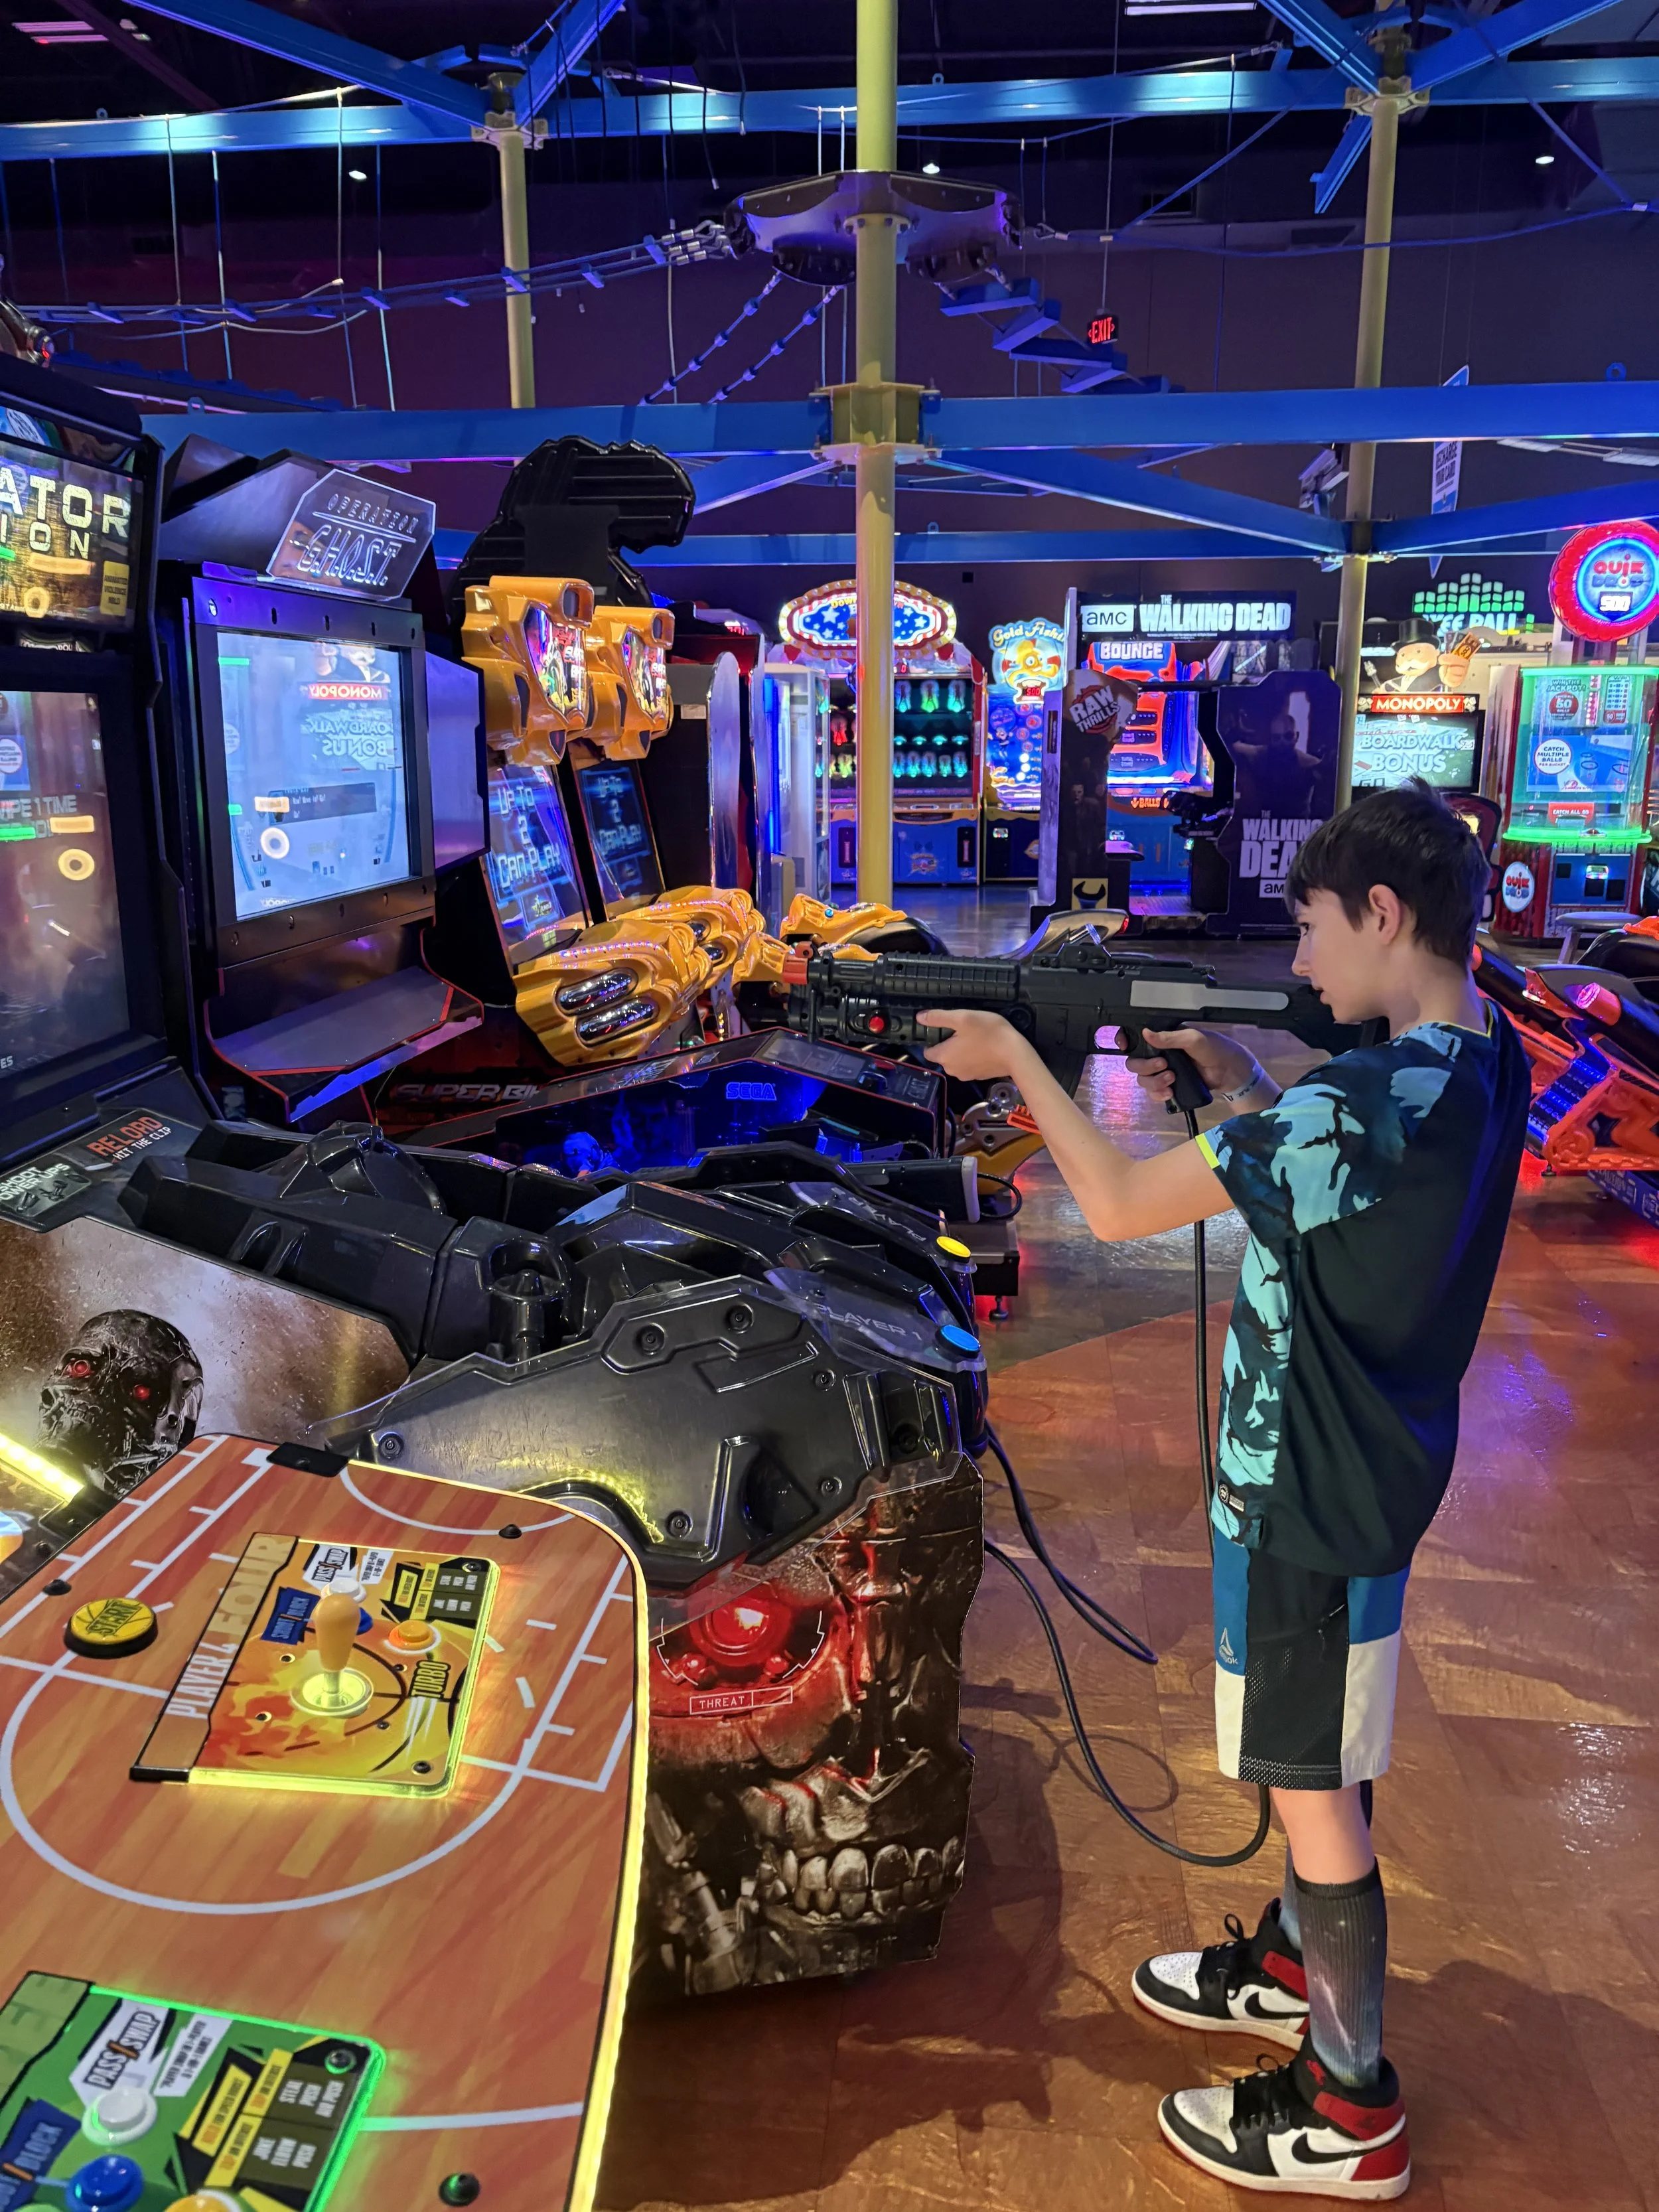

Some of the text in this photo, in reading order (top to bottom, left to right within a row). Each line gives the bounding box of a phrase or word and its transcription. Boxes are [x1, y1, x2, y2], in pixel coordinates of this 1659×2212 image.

[1092, 317, 1113, 344] EXIT
[0, 467, 132, 538] ATOR
[327, 493, 419, 534] OPERATION
[1160, 594, 1173, 605] THE
[1600, 595, 1631, 612] 500
[1139, 603, 1234, 632] WALKING
[1235, 602, 1292, 631] DEAD
[993, 625, 1024, 647] Gold
[1100, 642, 1164, 660] BOUNCE
[1026, 688, 1041, 696] 500
[1555, 698, 1573, 709] 60
[1069, 685, 1115, 723] RAW
[1376, 697, 1461, 711] MONOPOLY
[1076, 701, 1121, 733] THRILLS
[1361, 733, 1462, 751] BOARDWALK
[1372, 751, 1447, 773] BONUS
[42, 794, 78, 814] TIME
[516, 785, 535, 810] TO
[1139, 797, 1161, 808] BALLS
[611, 798, 622, 823] 2
[1261, 810, 1271, 819] THE
[518, 815, 532, 845] 2
[529, 842, 561, 878] PLAY
[394, 1084, 502, 1100] SUPER
[725, 1082, 777, 1102] SEGA
[86, 1116, 164, 1157] RELOAD
[112, 1126, 173, 1160] HIT THE CLIP
[43, 1163, 71, 1179] UPS
[813, 1302, 922, 1341] PLAYER 1
[87, 1600, 141, 1637] START
[165, 1534, 298, 1720] PLAYER 4 FOUR
[411, 1660, 450, 1698] TURBO
[699, 1696, 745, 1710] THREAT
